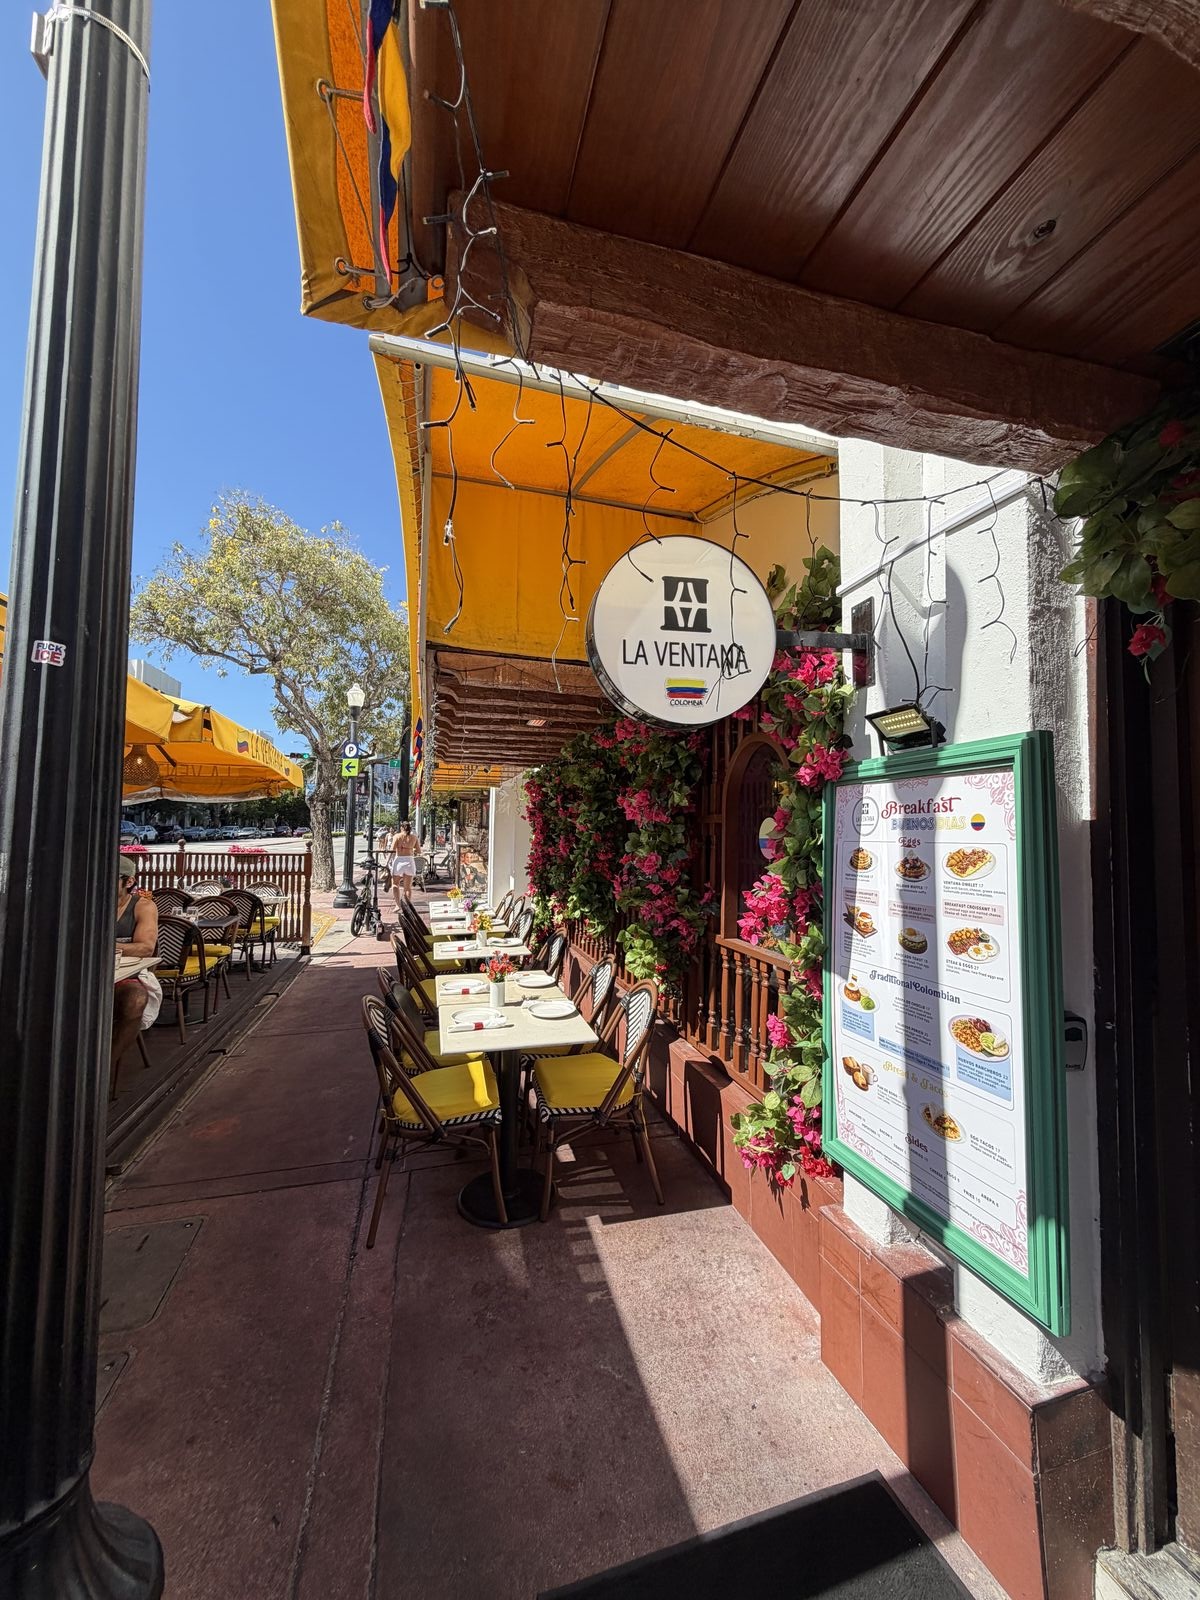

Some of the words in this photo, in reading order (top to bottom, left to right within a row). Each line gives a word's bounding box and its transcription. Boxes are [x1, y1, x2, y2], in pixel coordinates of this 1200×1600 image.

[36, 642, 62, 653] FUCK
[622, 639, 648, 665] LA
[654, 640, 748, 669] VENTANA
[35, 650, 62, 664] ICE
[250, 733, 260, 760] LA
[881, 797, 961, 819] Breakfast
[891, 817, 935, 830] BUENOS
[898, 837, 920, 848] Eggs
[869, 970, 912, 990] Traditional
[912, 981, 961, 1004] Colombian
[905, 1133, 928, 1152] Sides
[980, 1139, 994, 1150] TACOS
